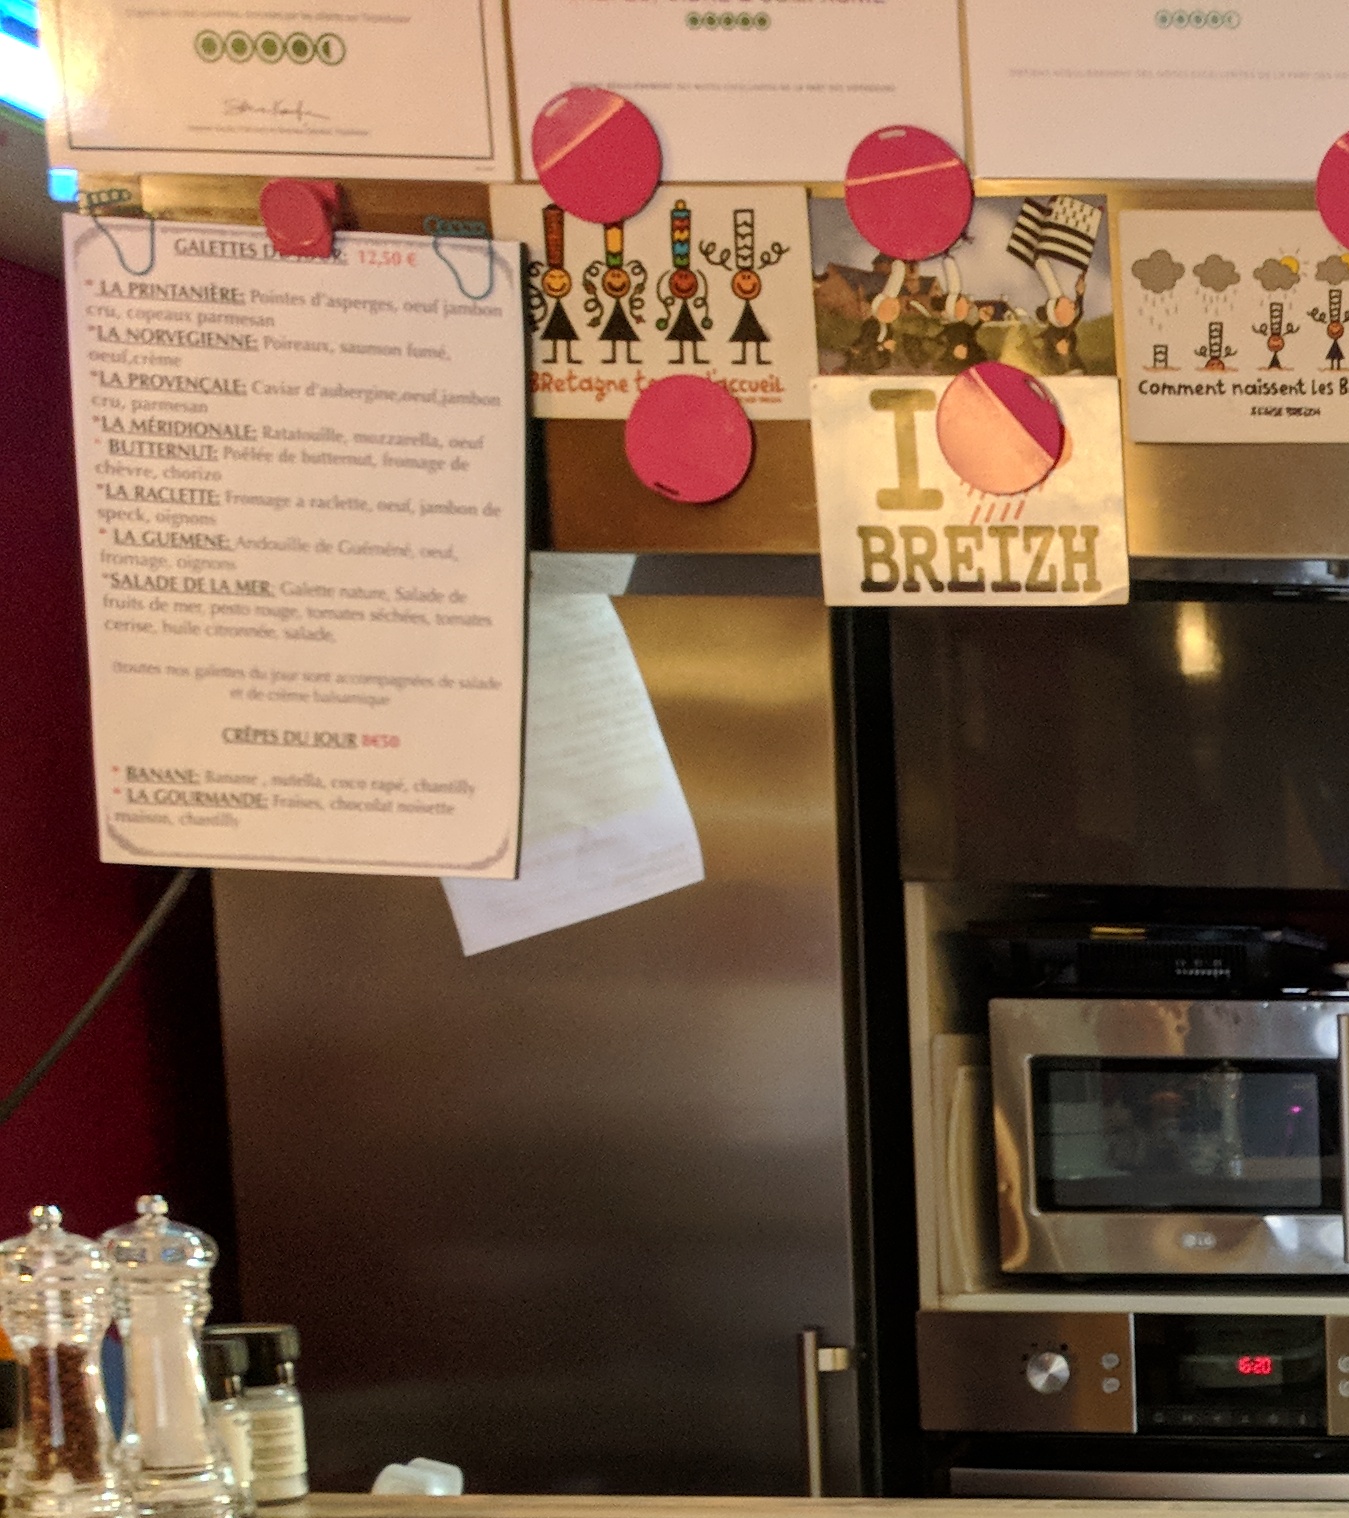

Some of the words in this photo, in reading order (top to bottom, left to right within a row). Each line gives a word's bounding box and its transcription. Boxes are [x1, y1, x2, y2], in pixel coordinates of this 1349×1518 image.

[174, 238, 257, 258] GALETTES
[100, 280, 122, 297] LA
[128, 281, 245, 304] PRINTANIÈRE:
[250, 288, 306, 305] Pointes
[85, 305, 120, 320] cru,
[127, 307, 191, 323] copeaux
[197, 310, 275, 330] parmesan
[97, 325, 119, 342] LA
[126, 327, 258, 351] NORVEGIENNE:
[263, 335, 334, 354] Poireaux,
[339, 342, 402, 356] saumon
[100, 370, 122, 388] LA
[128, 372, 247, 395] PROVENÇALE:
[251, 380, 301, 397] Caviar
[1138, 379, 1227, 397] Comment
[1232, 377, 1306, 397] naissent
[91, 396, 125, 410] cru,
[131, 398, 208, 414] parmesan
[101, 415, 124, 432] LA
[130, 416, 257, 441] MÉRIDIONALE:
[108, 438, 218, 461] BUTTERNUT:
[278, 448, 296, 463] de
[382, 452, 446, 474] fromage
[451, 456, 470, 471] de
[869, 389, 944, 510] I
[163, 465, 222, 481] chorizo
[105, 483, 127, 500] LA
[134, 484, 220, 506] RACLETTE:
[225, 489, 291, 510] Fromage
[419, 499, 478, 517] jambon
[482, 502, 501, 517] de
[98, 508, 149, 524] speck,
[155, 509, 217, 527] oignons
[114, 528, 135, 546] LA
[236, 534, 311, 553] Andouille
[315, 537, 333, 553] de
[176, 555, 237, 571] oignons
[856, 525, 1102, 593] BREIZH
[111, 572, 179, 593] SALADE
[183, 577, 205, 593] DE
[211, 578, 230, 594] LA
[279, 580, 335, 598] Galette
[395, 586, 445, 603] Salade
[448, 589, 467, 604] de
[103, 593, 144, 610] fruits
[150, 597, 168, 611] de
[210, 603, 250, 619] pesto
[306, 606, 365, 621] tomates
[435, 613, 493, 627] tomates
[162, 620, 200, 635] huile
[284, 729, 310, 747] DU
[127, 788, 147, 805] LA
